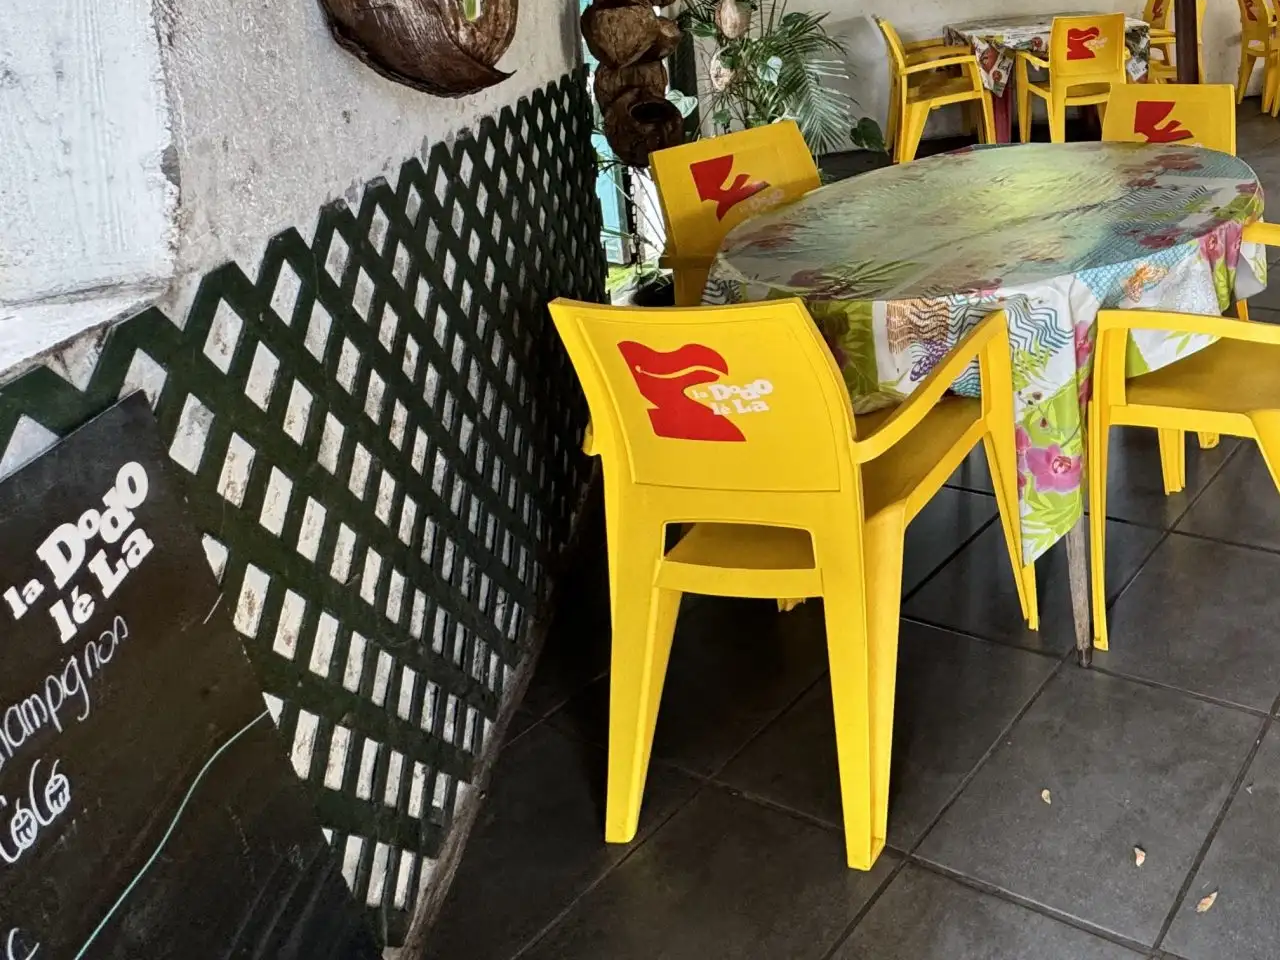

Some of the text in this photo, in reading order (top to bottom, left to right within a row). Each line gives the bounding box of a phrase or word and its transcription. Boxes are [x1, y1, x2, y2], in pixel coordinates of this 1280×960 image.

[3, 578, 45, 620] la
[49, 528, 154, 644] lé La
